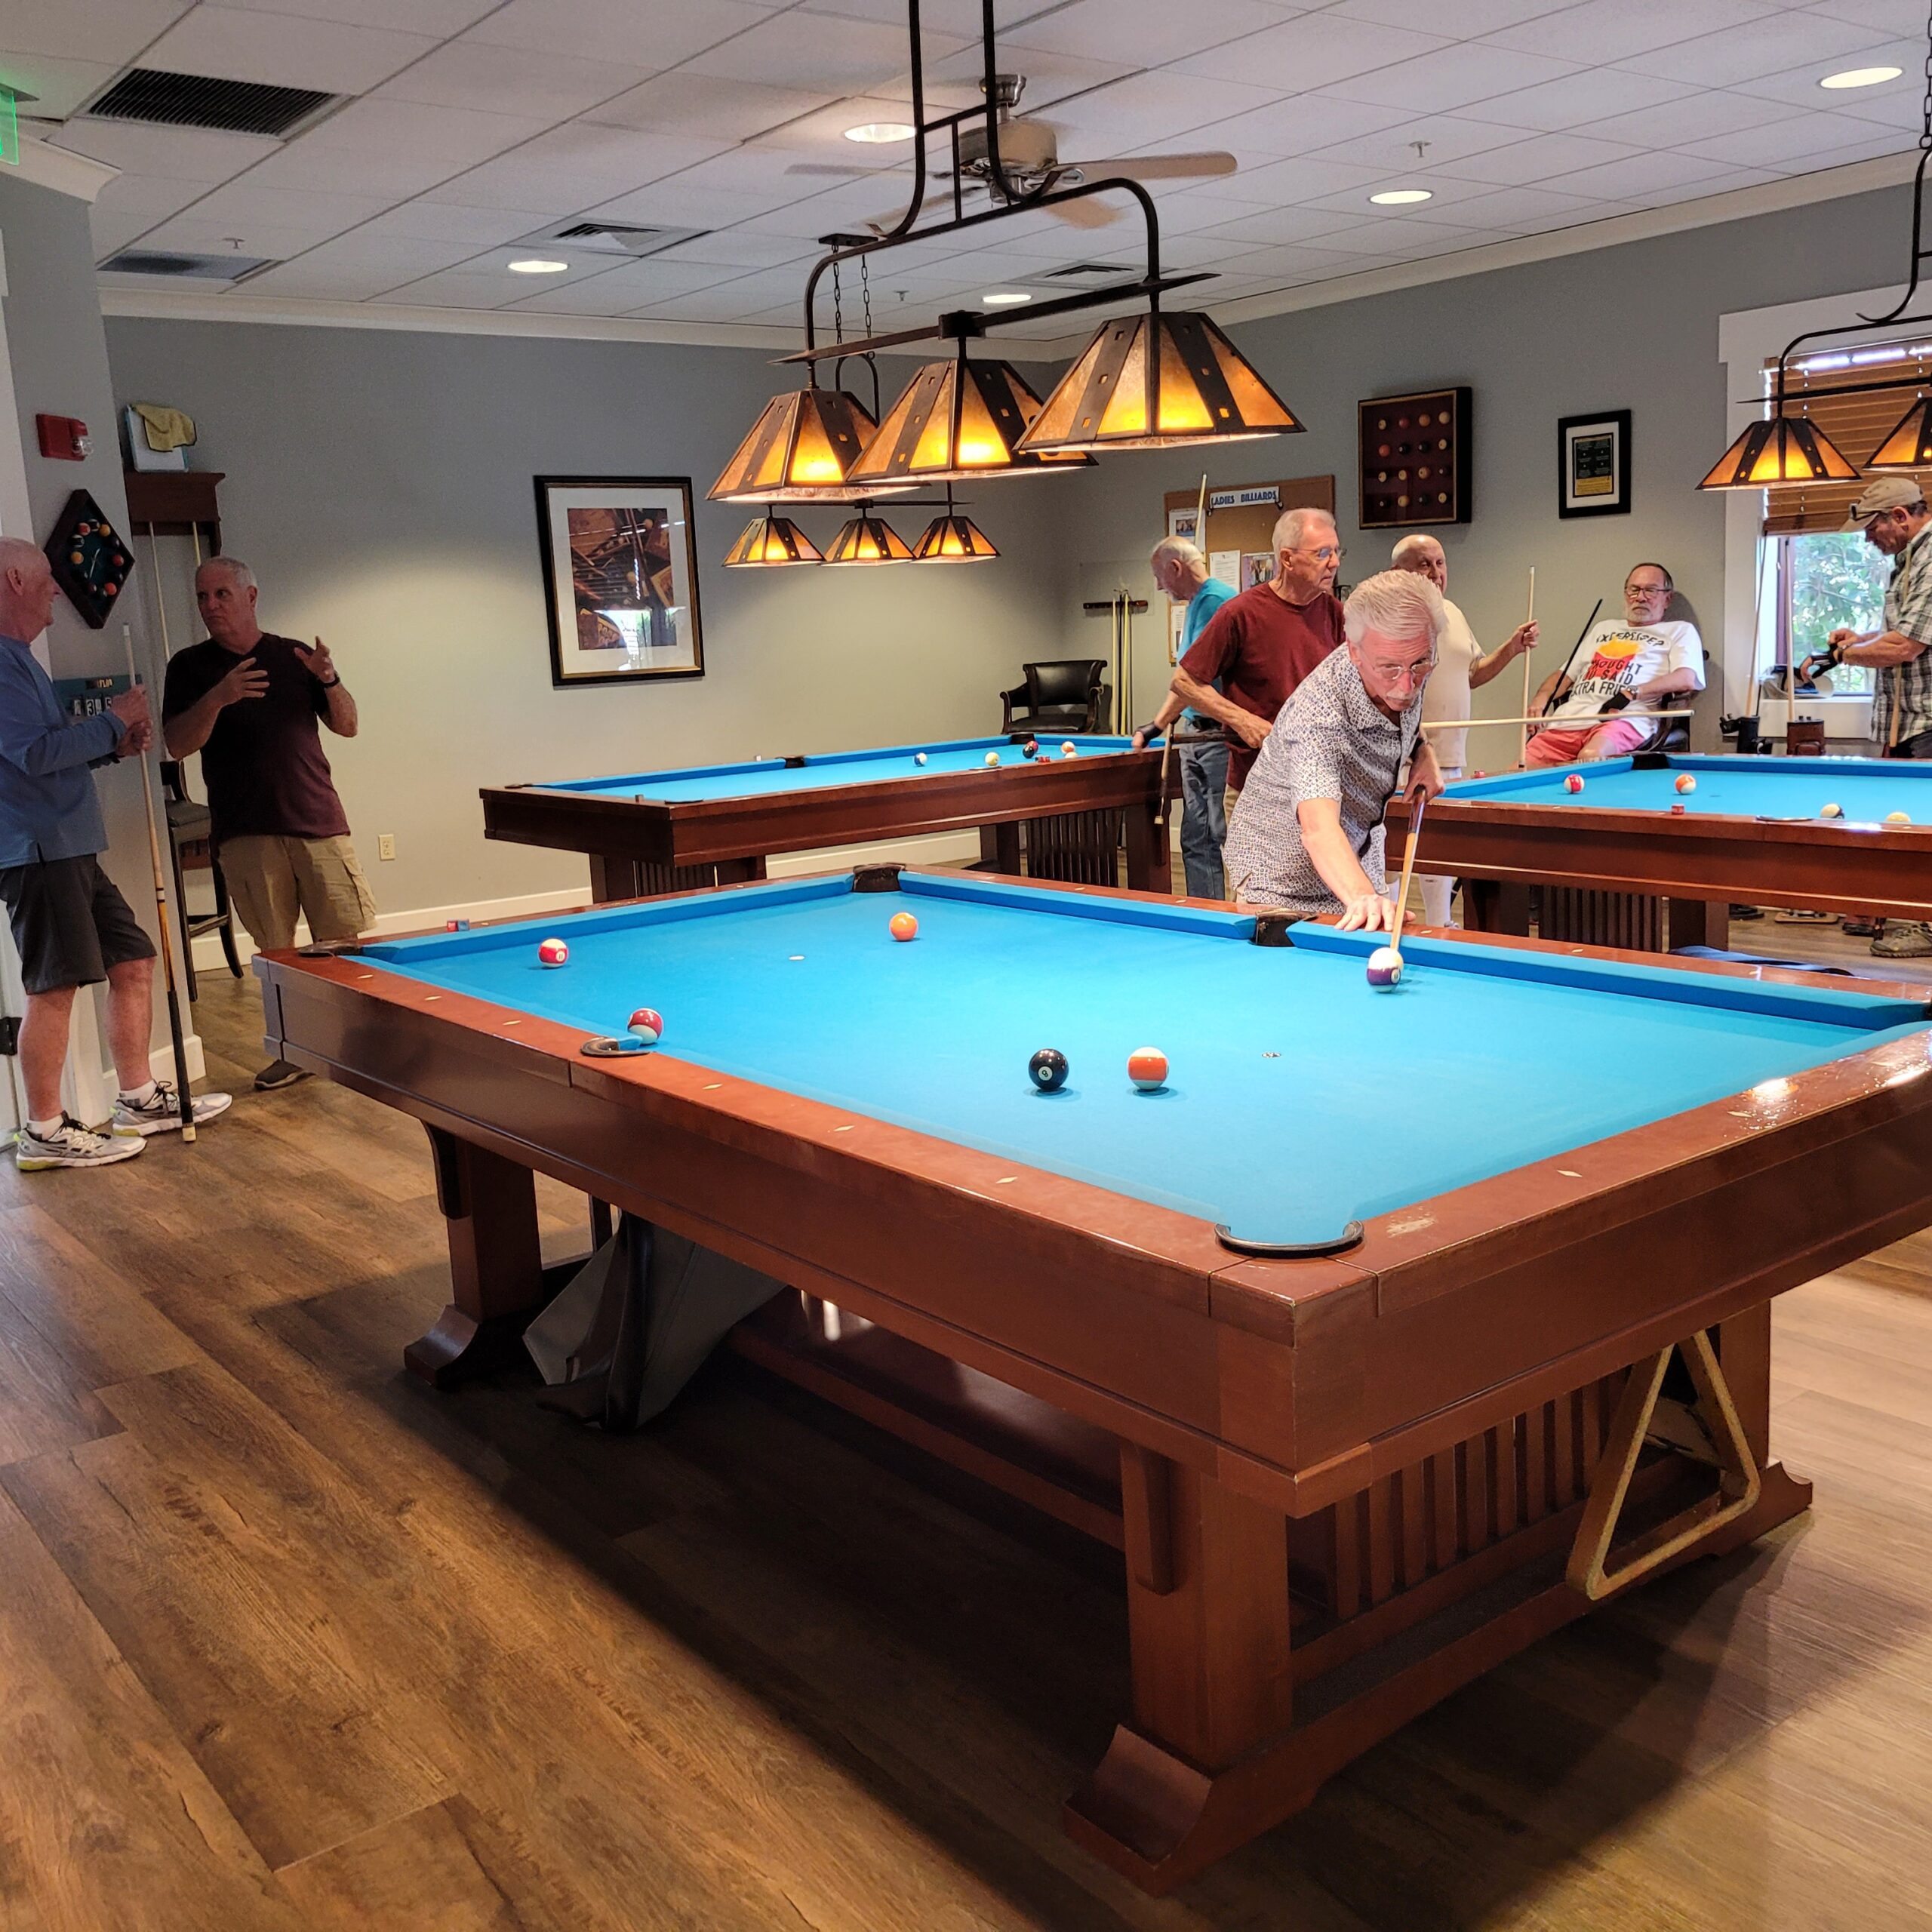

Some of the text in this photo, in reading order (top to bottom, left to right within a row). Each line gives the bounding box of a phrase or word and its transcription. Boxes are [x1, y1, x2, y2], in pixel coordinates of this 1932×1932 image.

[1211, 491, 1276, 505] LADIES BILLIARDS
[1601, 669, 1633, 685] SAID
[1571, 680, 1626, 697] XTRA FRIE
